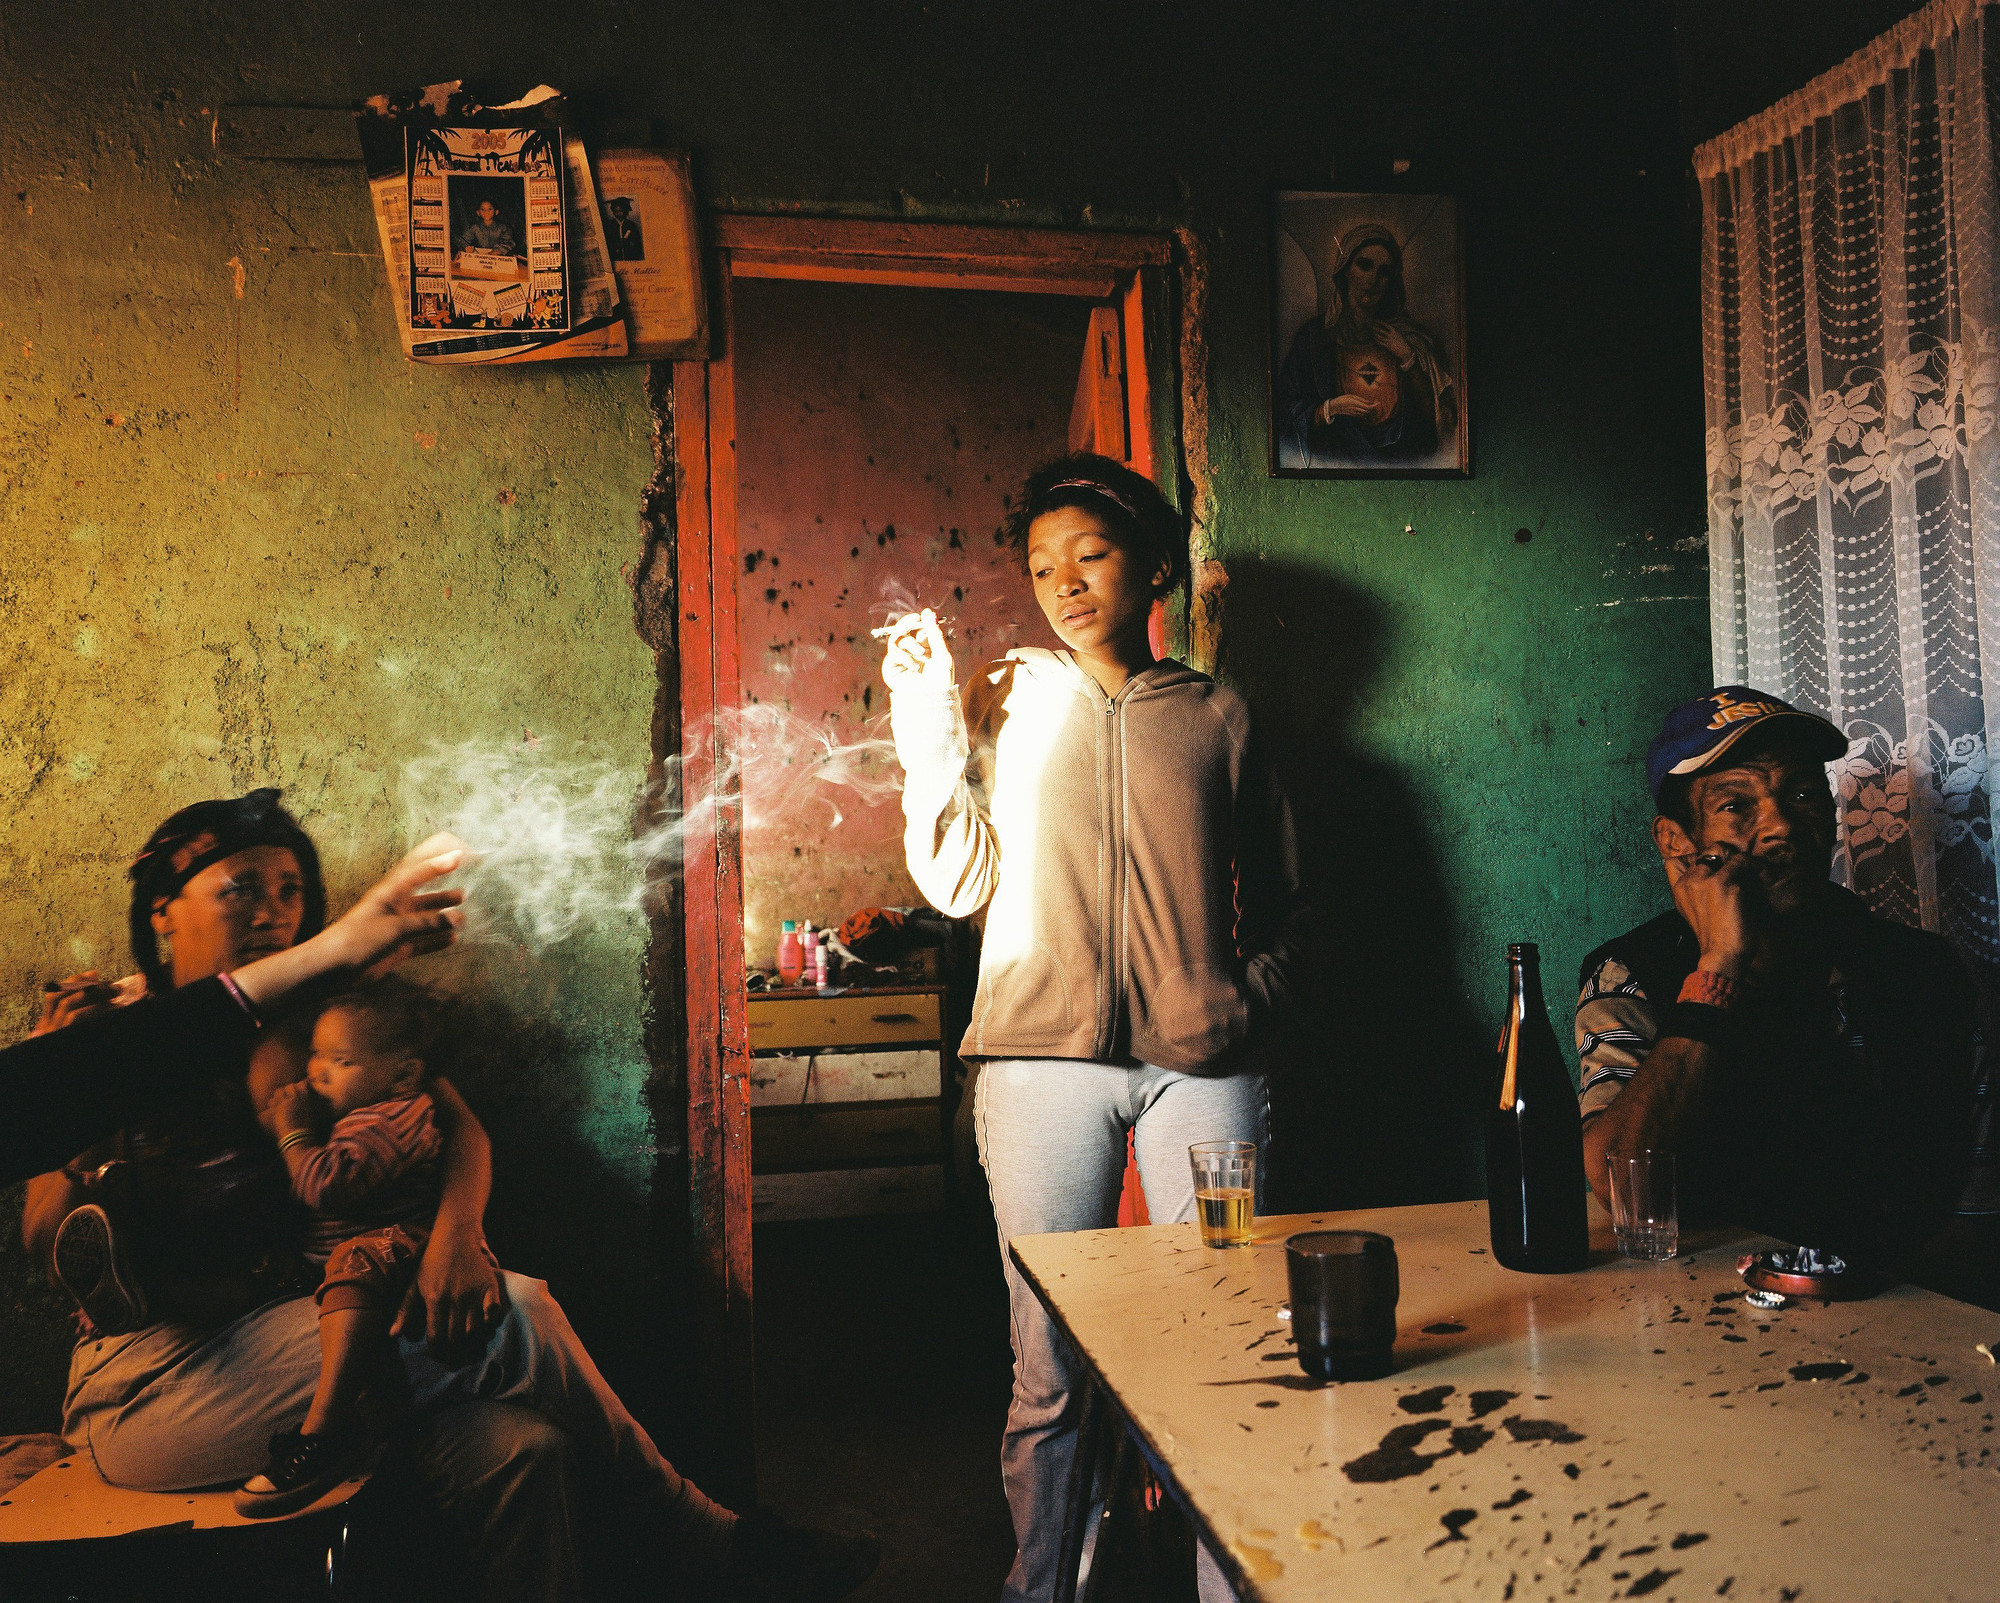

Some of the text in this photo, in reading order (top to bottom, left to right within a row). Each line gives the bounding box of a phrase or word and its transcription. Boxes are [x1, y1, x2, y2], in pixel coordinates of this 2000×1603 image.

[471, 132, 507, 150] 2005
[600, 164, 666, 173] rawford Primary
[627, 284, 676, 294] hool Career
[1709, 692, 1737, 709] I
